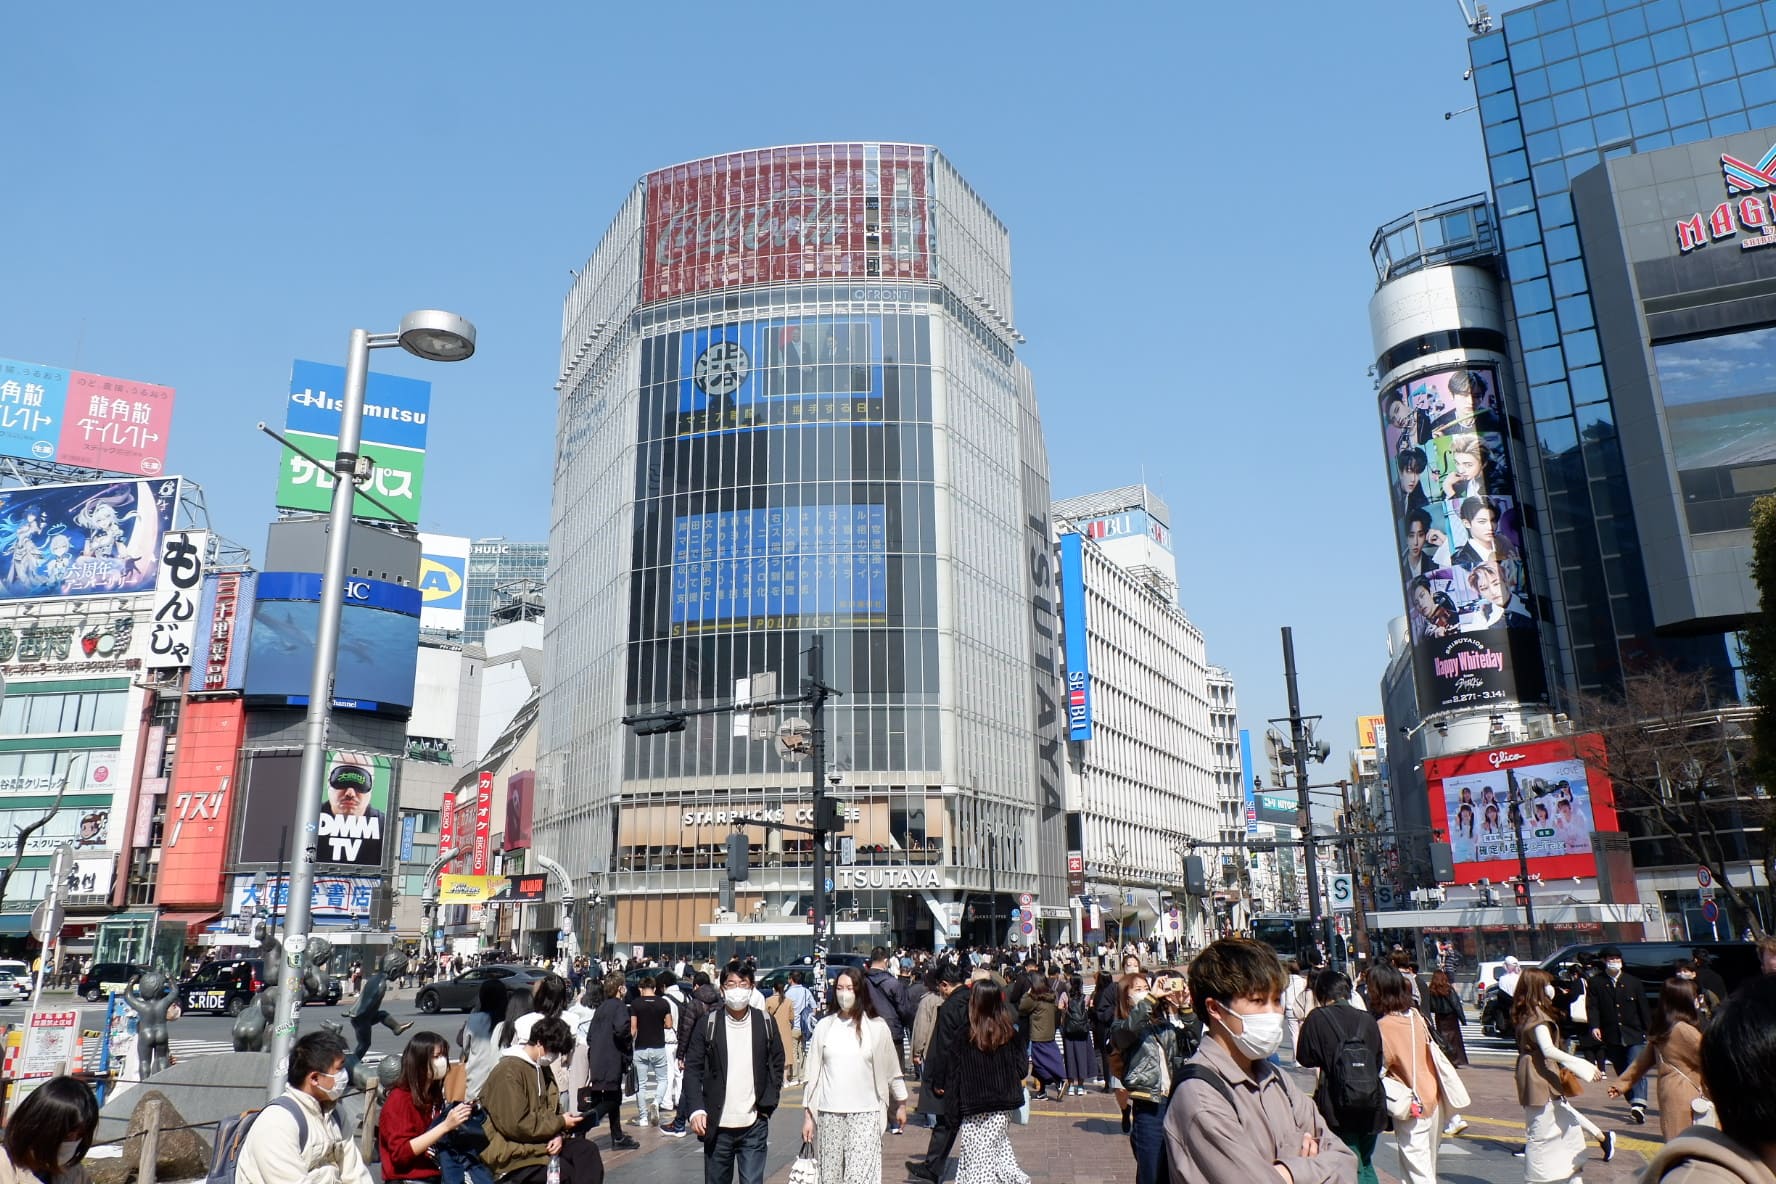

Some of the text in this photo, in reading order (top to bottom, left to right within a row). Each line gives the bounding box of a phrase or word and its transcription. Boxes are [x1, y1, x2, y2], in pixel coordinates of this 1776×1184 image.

[0, 405, 52, 432] レクト
[89, 395, 152, 425] 龍角散
[292, 388, 426, 425] Hismitsu
[77, 418, 159, 449] ダイレクト
[1076, 515, 1131, 539] EIBU
[475, 545, 509, 554] HULIC
[151, 533, 201, 663] もんじゃ
[756, 616, 831, 629] POLITICS
[1028, 512, 1064, 820] TSUTAYA
[1434, 648, 1503, 678] Happy Whiteday
[1068, 671, 1087, 731] SEIBU
[1488, 751, 1526, 769] Glico
[475, 778, 490, 831] カラオケ
[795, 807, 861, 823] COEE
[318, 812, 380, 840] DMM
[328, 837, 363, 862] TV
[839, 868, 942, 889] TSUTAYA
[1334, 878, 1349, 900] S
[188, 995, 225, 1009] S.RIDE
